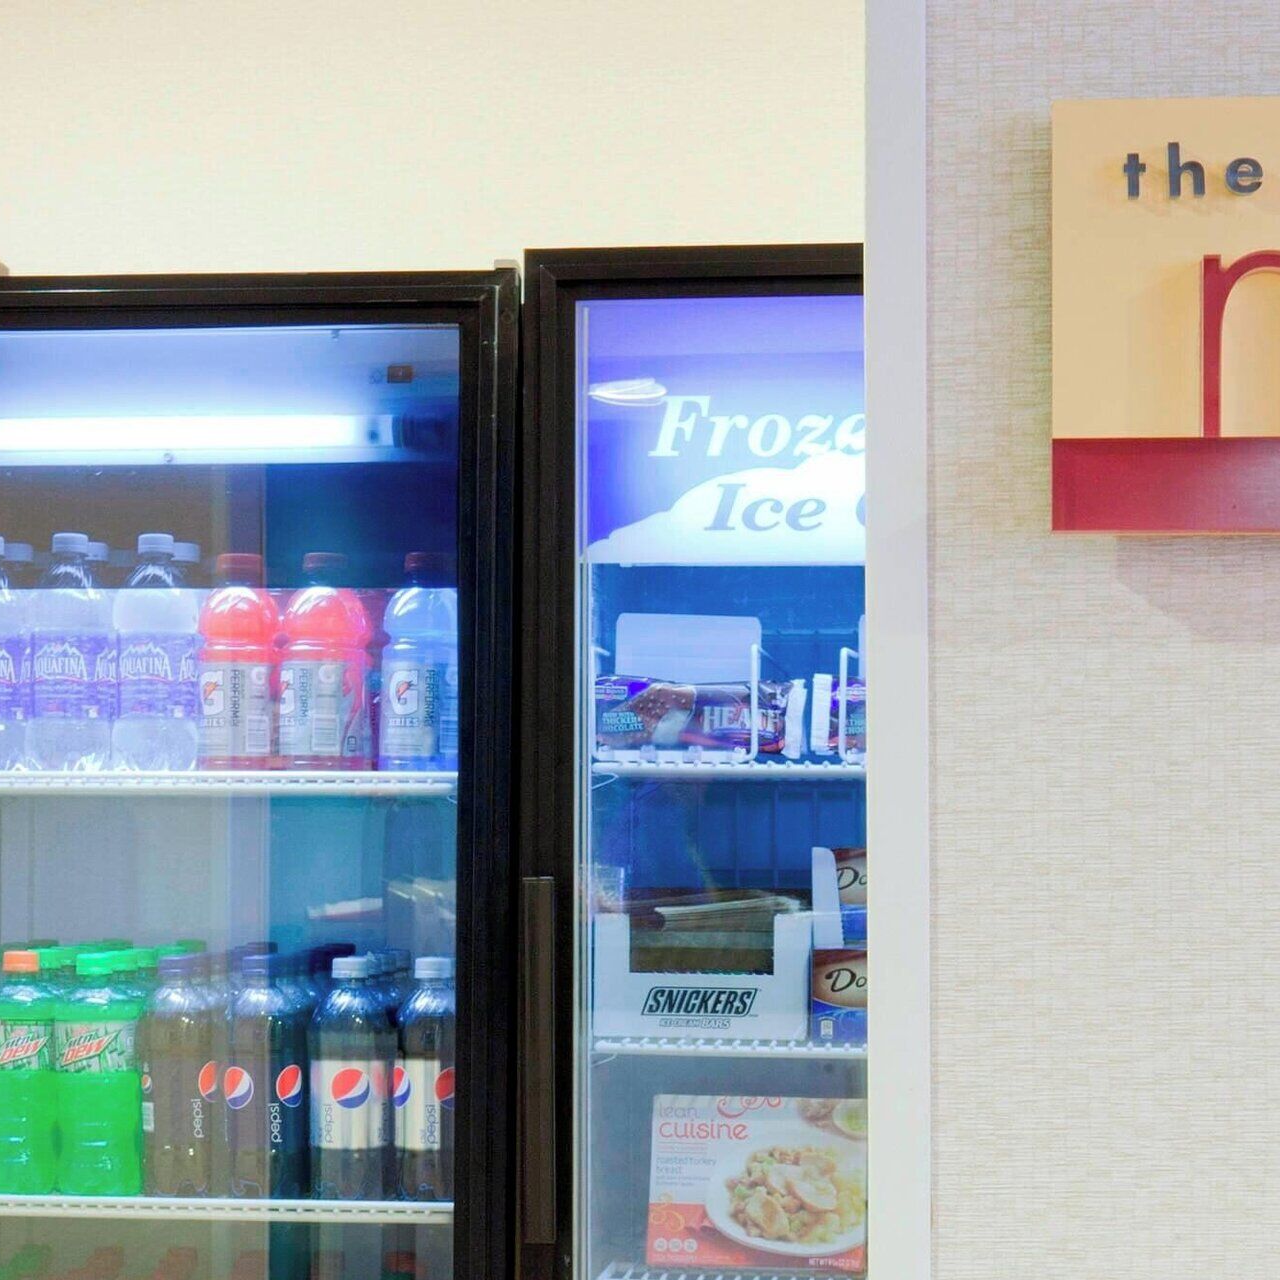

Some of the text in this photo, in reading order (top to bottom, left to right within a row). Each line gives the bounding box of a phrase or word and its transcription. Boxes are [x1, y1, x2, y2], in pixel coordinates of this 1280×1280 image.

[1123, 141, 1265, 199] the
[704, 483, 827, 531] Ice
[389, 669, 418, 716] G
[647, 987, 755, 1015] SNICKERS
[192, 1098, 205, 1139] pepsi
[268, 1103, 282, 1143] pepsi
[323, 1103, 335, 1144] pepsi
[425, 1104, 437, 1145] pepsi
[659, 1119, 749, 1140] cuisine
